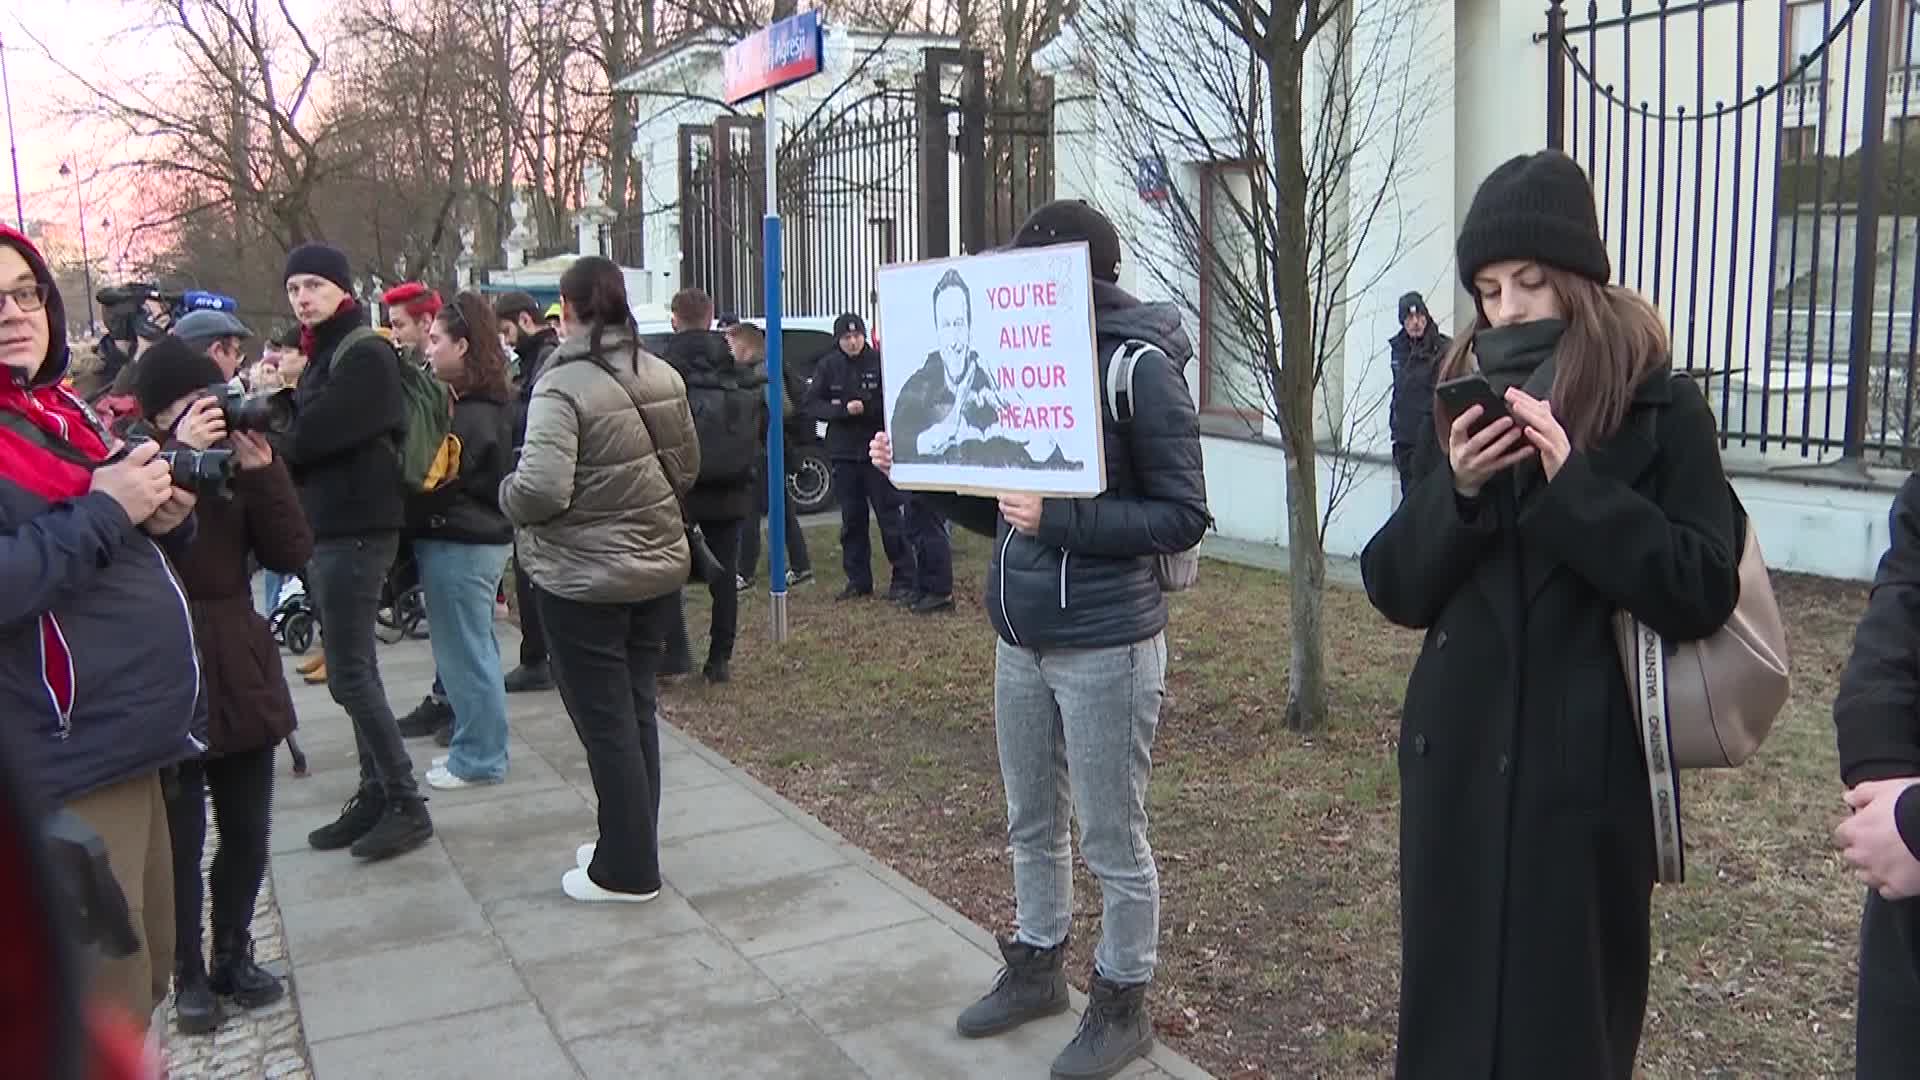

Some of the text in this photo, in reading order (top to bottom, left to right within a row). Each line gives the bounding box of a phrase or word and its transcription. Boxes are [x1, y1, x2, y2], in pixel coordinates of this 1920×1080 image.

[776, 27, 806, 67] Agresji
[986, 283, 1057, 310] YOU'RE
[1000, 325, 1052, 349] ALIVE
[997, 366, 1067, 389] IN OUR
[999, 405, 1075, 429] HEARTS
[1645, 631, 1658, 699] VALENTINO
